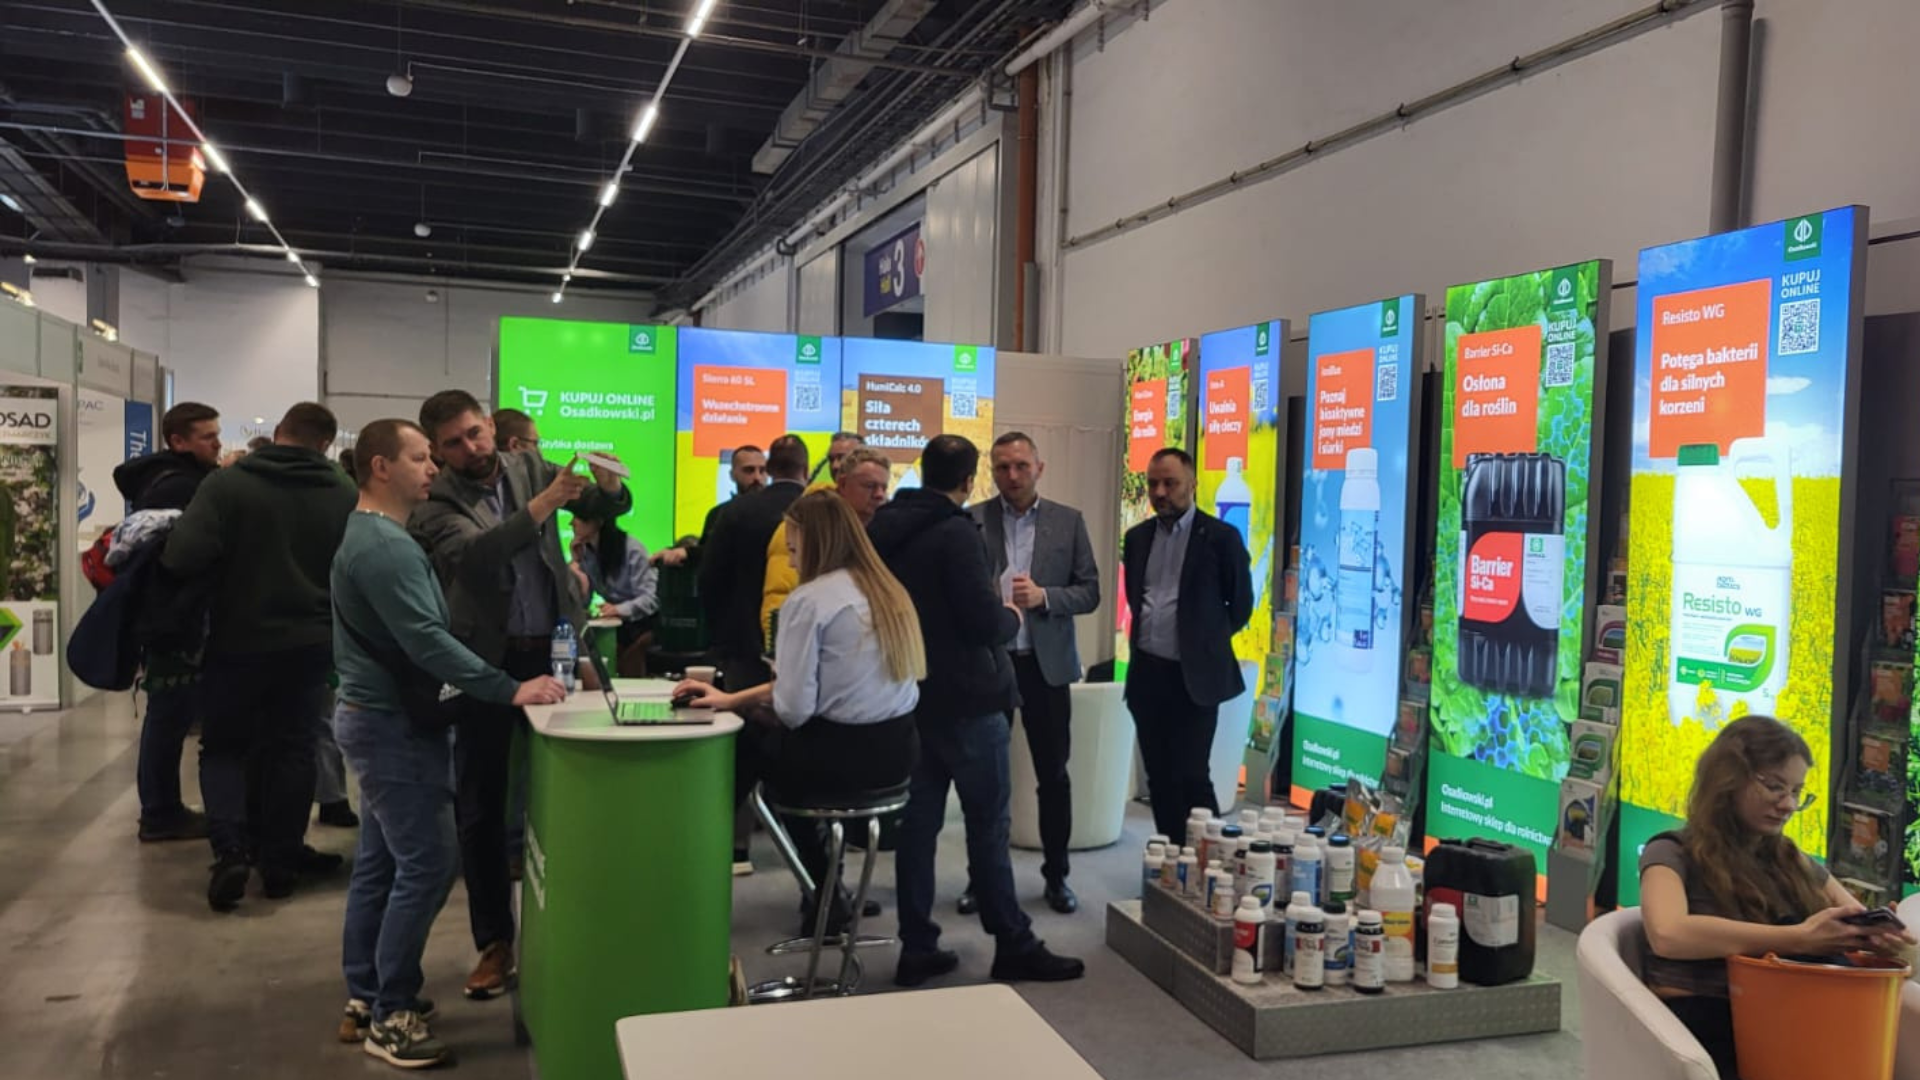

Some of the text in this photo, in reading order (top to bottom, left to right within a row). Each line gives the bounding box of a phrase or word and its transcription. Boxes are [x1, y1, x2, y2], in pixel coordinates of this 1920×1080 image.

[894, 239, 905, 297] 3
[1782, 269, 1820, 287] KUPUJ
[1781, 281, 1820, 299] ONLINE
[1662, 304, 1725, 326] Resisto WG
[1549, 318, 1577, 332] KUPUJ
[1549, 330, 1576, 342] ONLINE
[1464, 345, 1490, 359] Barrier
[1660, 343, 1759, 371] Potęga bakterii
[1462, 374, 1506, 393] Osłona
[1660, 372, 1725, 392] dla silnych
[560, 391, 655, 406] KUPUJ ONLINE
[702, 398, 780, 414] Wszechstronne
[865, 400, 891, 415] Siła
[1461, 397, 1517, 417] dla roślin
[1659, 397, 1705, 415] korzeni
[559, 405, 655, 421] Osadkowski.pl
[865, 418, 920, 432] czterech
[864, 433, 930, 449] składnikó
[1470, 554, 1513, 577] Barrier
[1682, 592, 1742, 615] Resisto
[1745, 607, 1763, 617] WG
